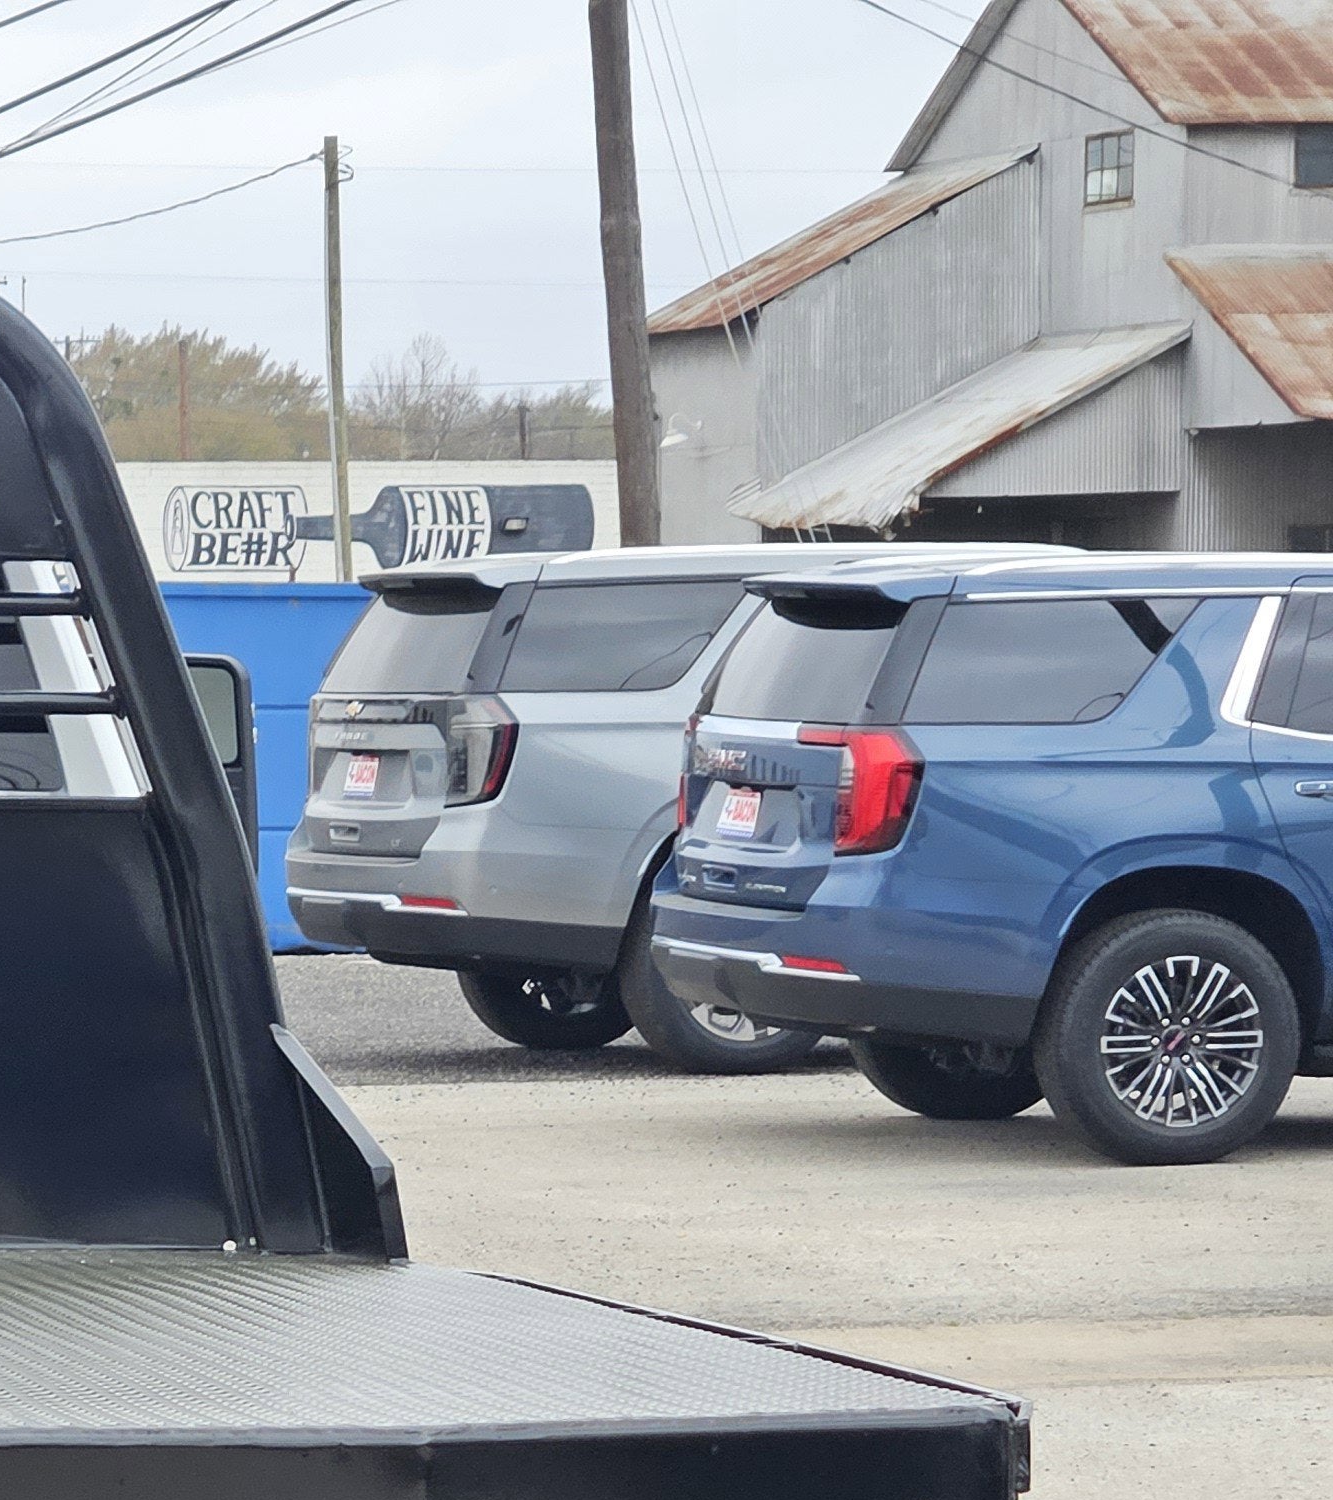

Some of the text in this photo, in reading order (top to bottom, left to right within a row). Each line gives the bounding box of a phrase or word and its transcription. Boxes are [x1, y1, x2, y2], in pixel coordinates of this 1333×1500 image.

[190, 490, 296, 529] CRAFT
[404, 490, 486, 525] FINE
[187, 531, 296, 566] BE#R
[405, 528, 485, 565] WINE
